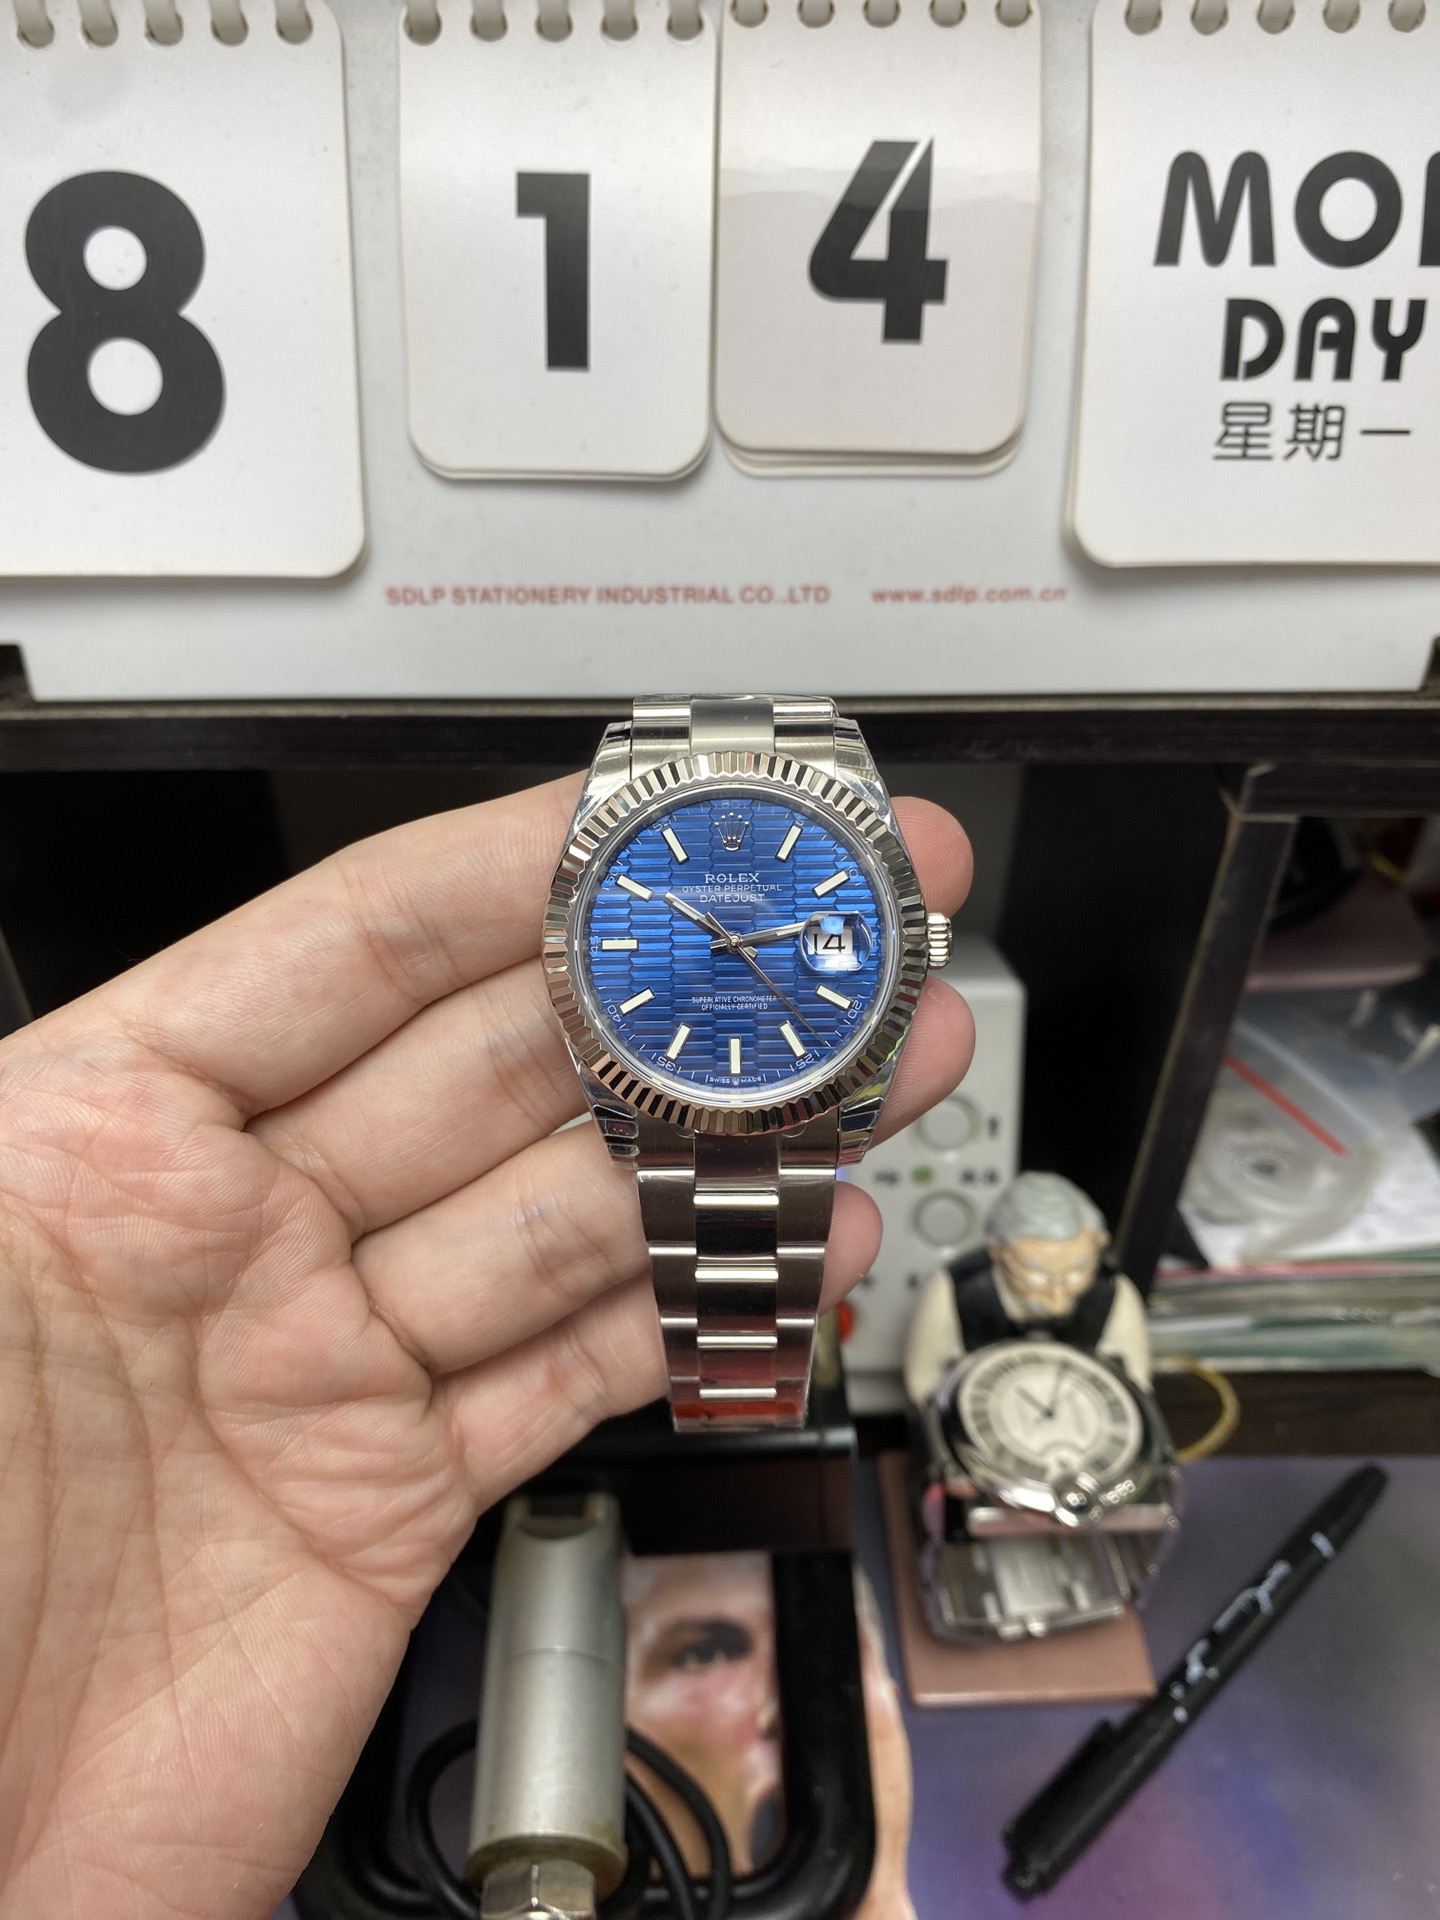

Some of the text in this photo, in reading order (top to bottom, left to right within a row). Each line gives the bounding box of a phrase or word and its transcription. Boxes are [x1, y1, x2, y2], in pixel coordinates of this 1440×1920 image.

[808, 138, 949, 344] 4
[516, 172, 590, 372] 1
[25, 170, 226, 475] 8
[1220, 297, 1427, 382] DAY
[1213, 401, 1412, 462] 星期一
[386, 585, 447, 606] SDLP
[451, 585, 592, 606] STATIONERY
[596, 584, 735, 606] INDUSTRIAL
[704, 872, 760, 884] ROLEX
[682, 884, 782, 894] OYSTER PERPETUAL
[699, 893, 766, 903] DATEJUST
[812, 933, 846, 953] 14
[606, 1004, 621, 1023] 40
[736, 1002, 768, 1010] CERTIFIED
[847, 1000, 862, 1017] 20
[656, 1056, 676, 1072] 35
[795, 1052, 815, 1070] 25
